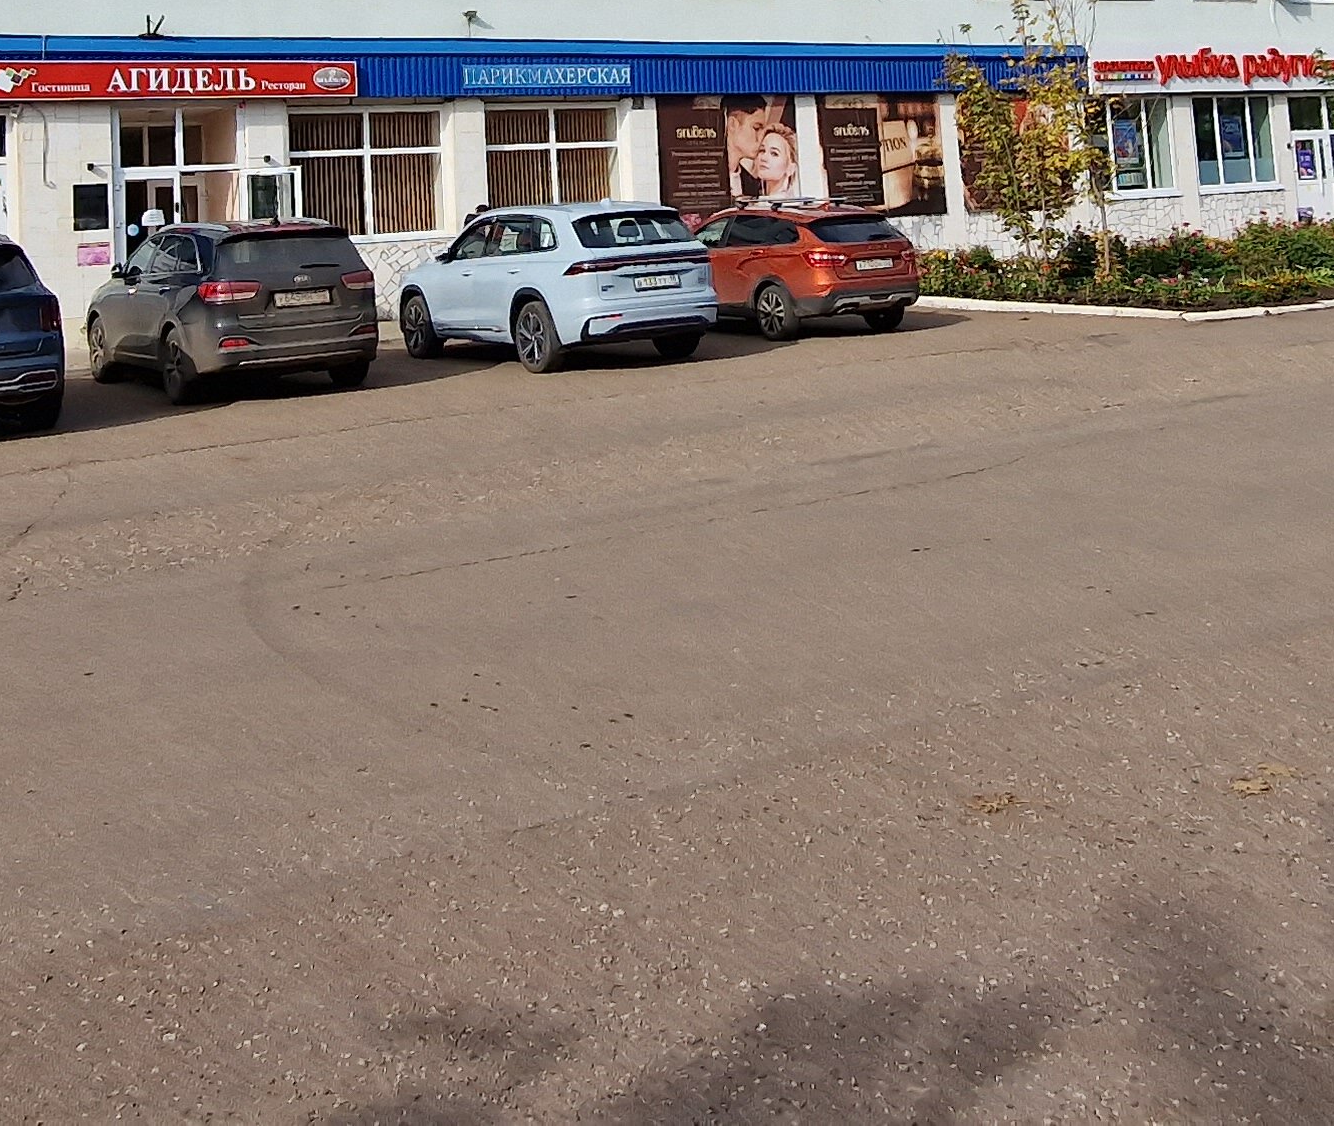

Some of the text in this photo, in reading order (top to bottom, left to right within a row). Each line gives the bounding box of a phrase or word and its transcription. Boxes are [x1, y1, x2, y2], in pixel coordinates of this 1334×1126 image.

[30, 67, 306, 94] Гостиница АГИДЕЛЬ Ресторан
[463, 67, 632, 85] ПАРИКМАХЕРСКАЯ
